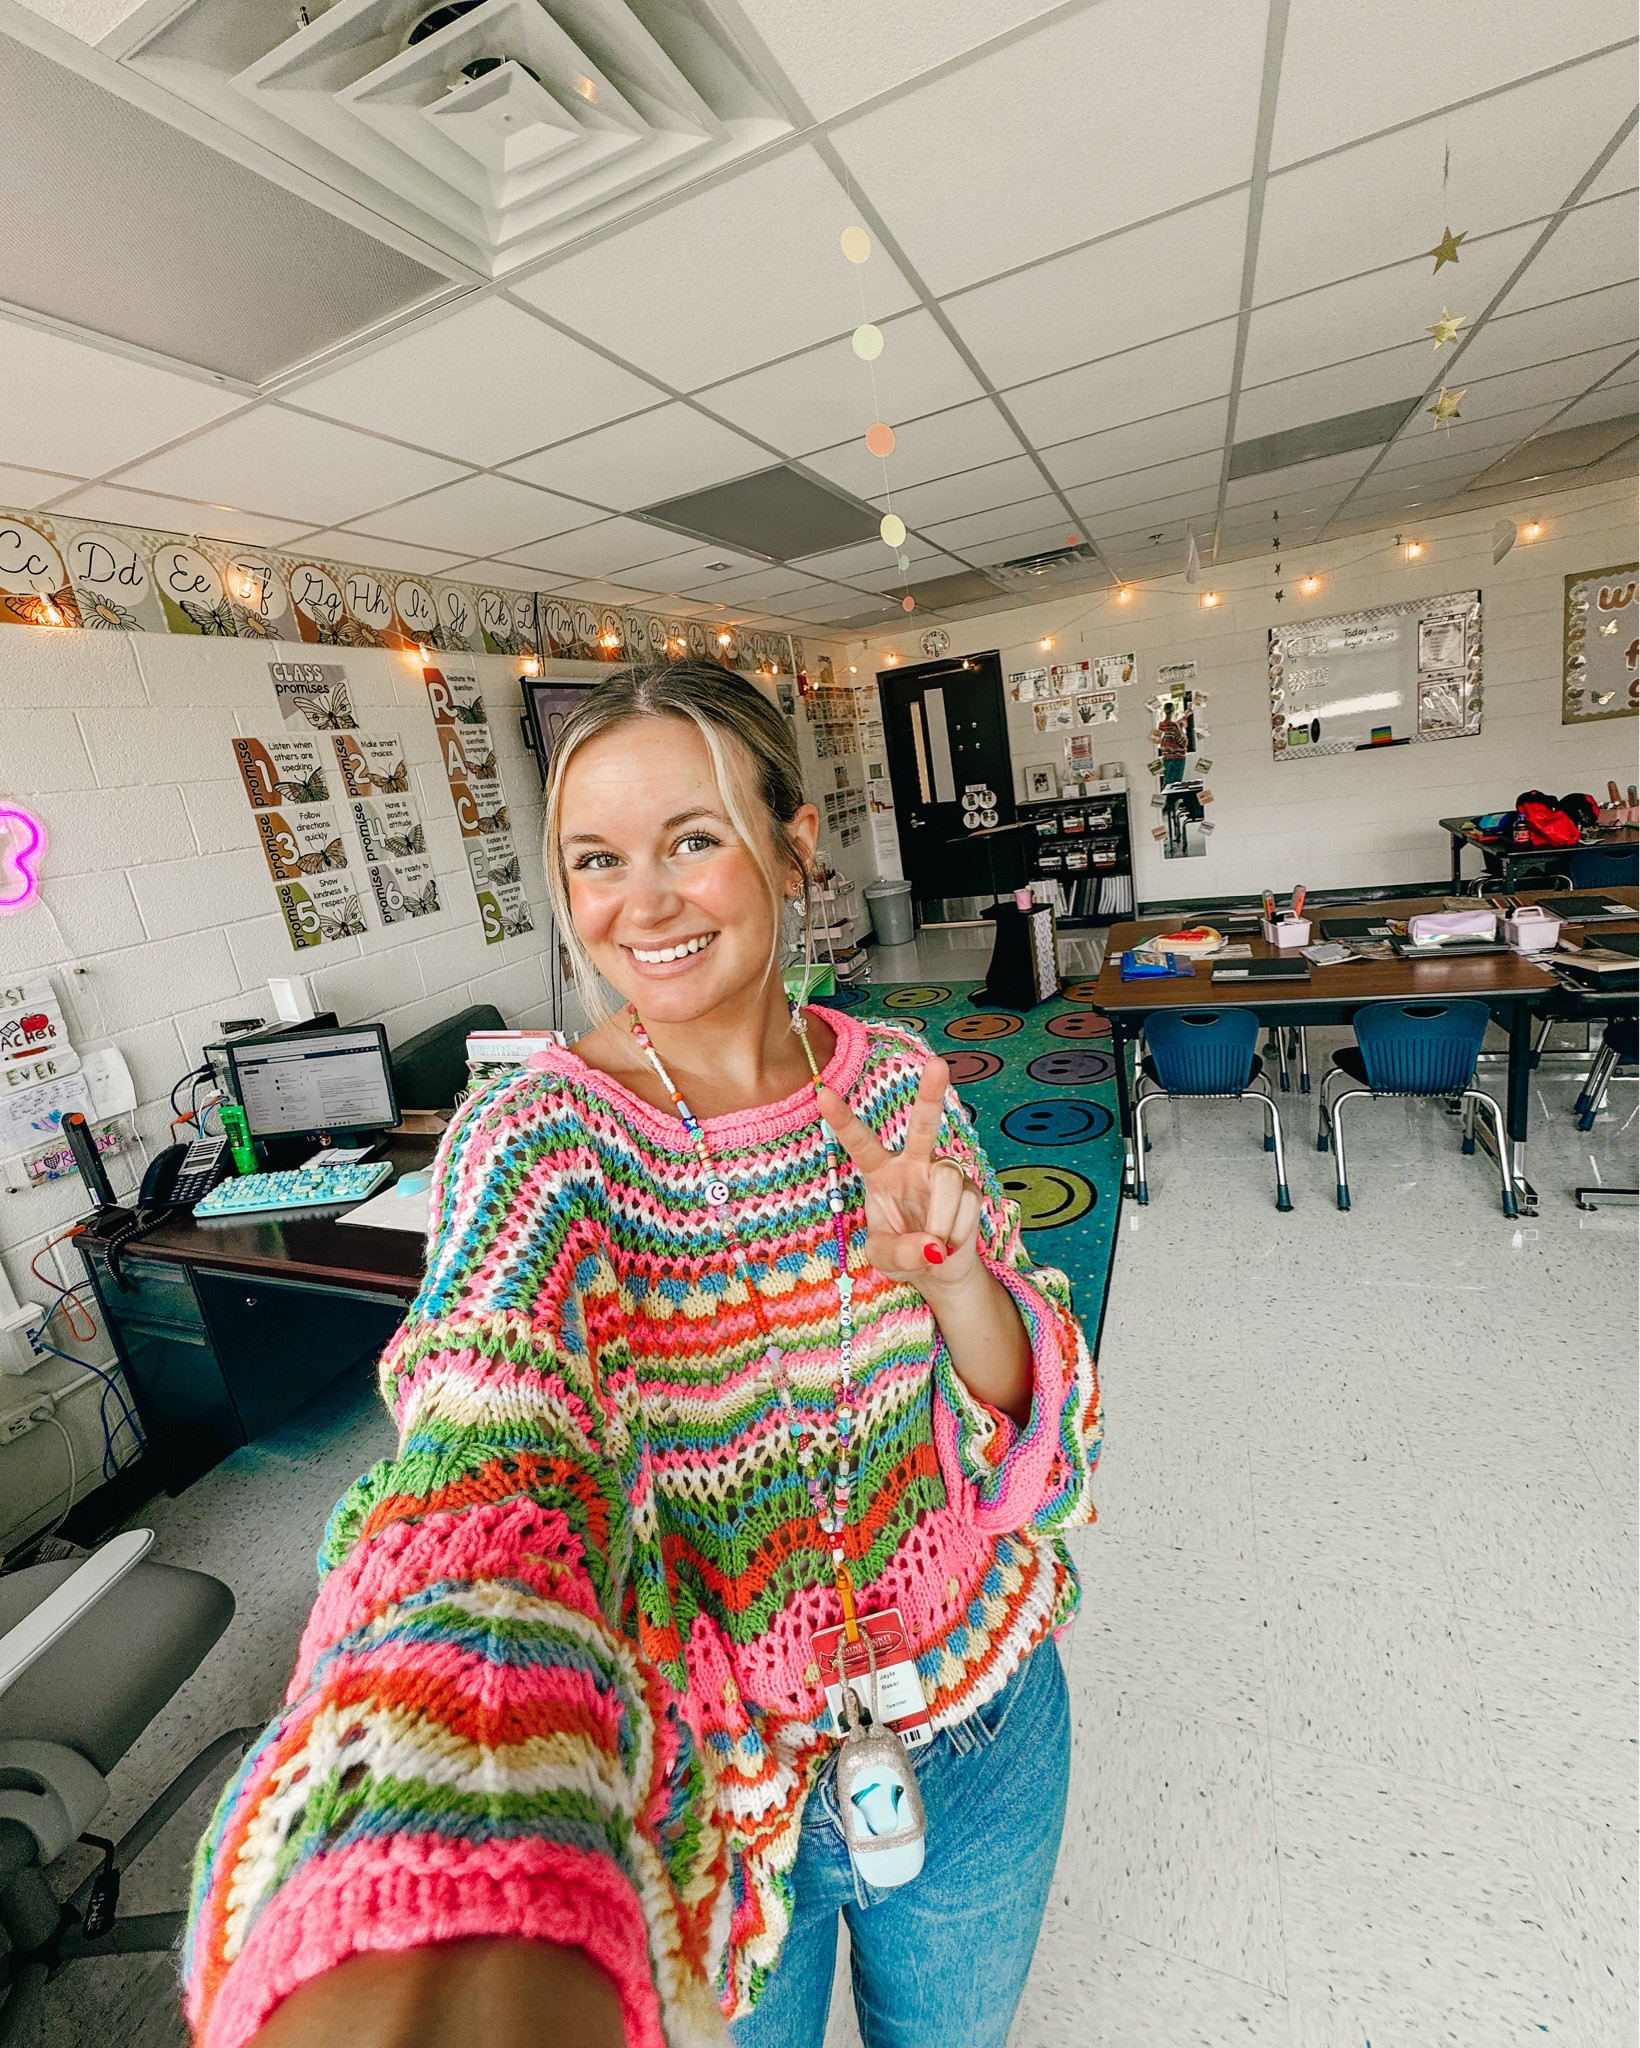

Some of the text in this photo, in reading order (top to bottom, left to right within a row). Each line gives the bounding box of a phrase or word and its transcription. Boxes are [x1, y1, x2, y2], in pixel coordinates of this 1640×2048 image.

[78, 542, 143, 585] Dd
[169, 554, 211, 592] Ee
[348, 579, 389, 614] Hh
[271, 662, 324, 682] CLASS
[275, 681, 330, 696] promises
[428, 682, 459, 719] R
[268, 740, 313, 750] Listen when
[274, 751, 313, 762] others are
[360, 740, 397, 749] Make smart
[371, 750, 392, 758] choices
[447, 738, 468, 777] A
[238, 739, 269, 806] promise
[255, 759, 273, 793] 1
[282, 761, 313, 774] speaking
[335, 736, 362, 797] promise
[349, 753, 371, 784] 2
[480, 782, 500, 790] evidence
[297, 822, 330, 832] directions
[299, 812, 321, 820] Follow
[387, 811, 409, 820] positive
[389, 820, 412, 829] attitude
[457, 796, 479, 830] C
[305, 833, 328, 842] quickly
[354, 802, 379, 861] promise
[260, 814, 289, 880] promise
[275, 831, 300, 865] 3
[404, 864, 420, 873] ready
[468, 849, 490, 886] E
[313, 887, 342, 899] kindness
[319, 879, 338, 887] Show
[371, 865, 396, 924] promise
[386, 880, 404, 911] 6
[281, 885, 310, 948] promise
[296, 899, 321, 934] 5
[321, 897, 347, 909] respect
[482, 902, 501, 938] S
[6, 1060, 57, 1086] EVER
[881, 1681, 899, 1690] Baker
